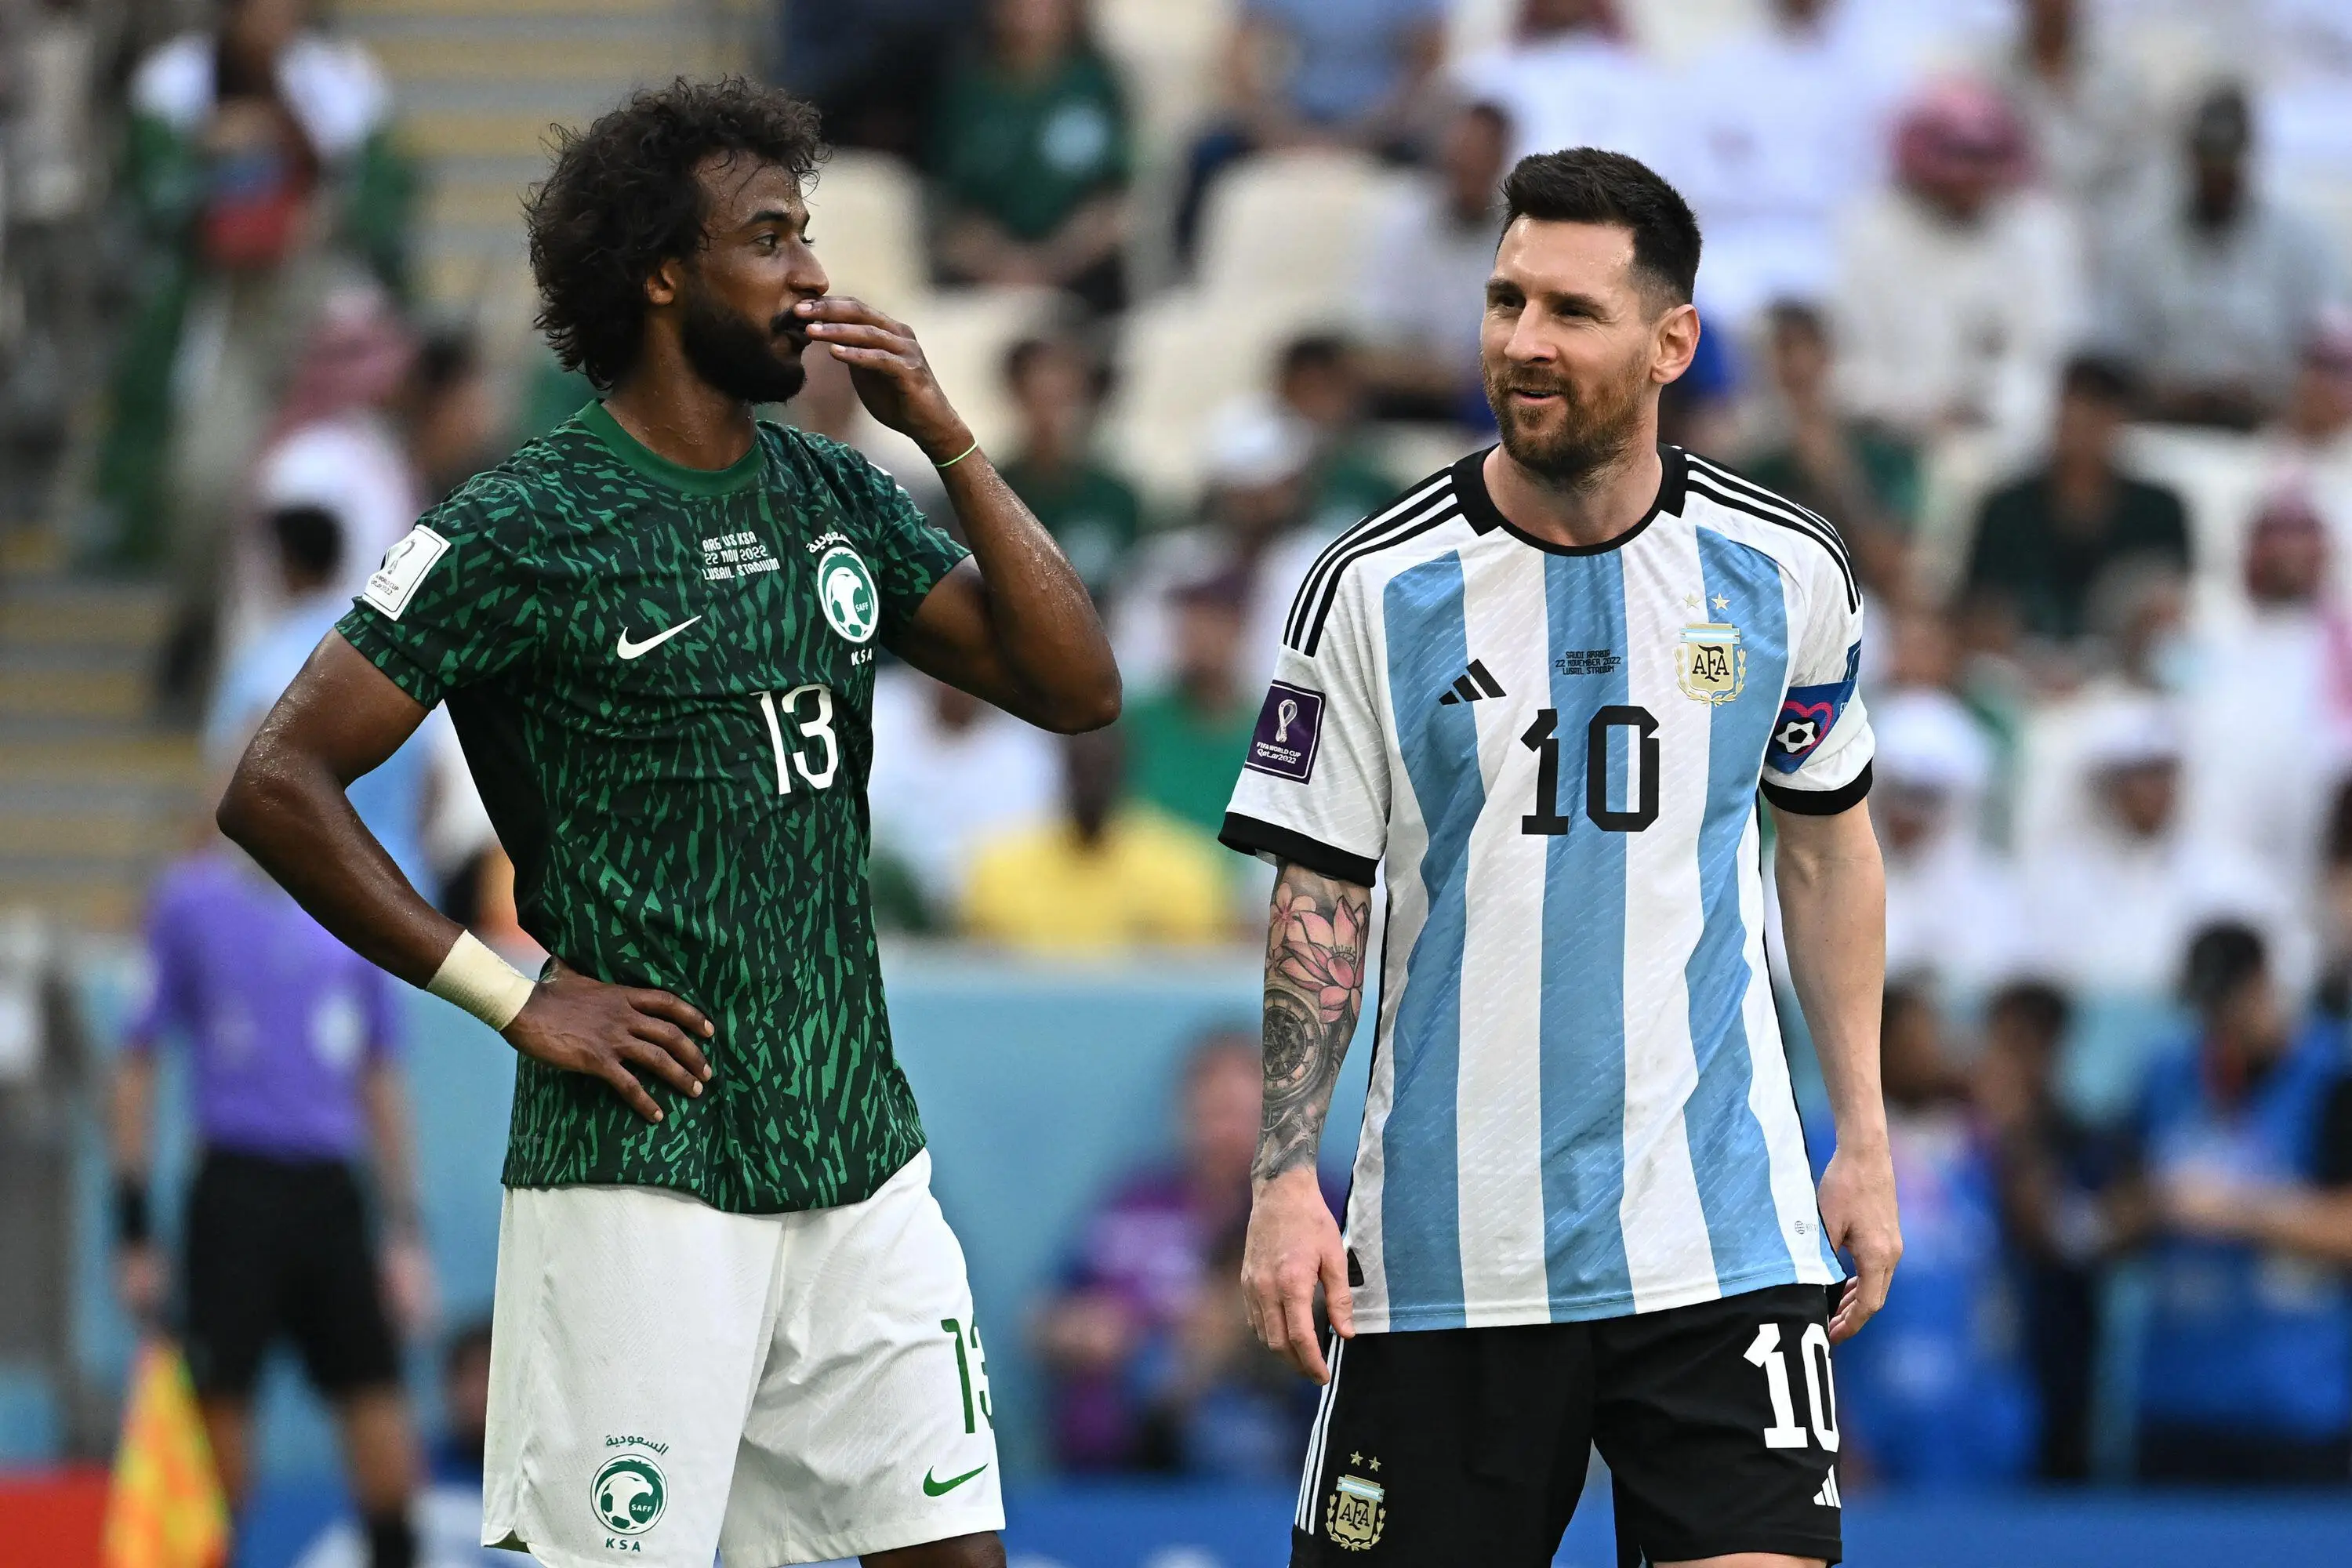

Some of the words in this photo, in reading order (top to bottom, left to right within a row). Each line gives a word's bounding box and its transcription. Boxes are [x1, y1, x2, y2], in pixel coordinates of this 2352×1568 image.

[702, 537, 722, 552] ARG
[737, 531, 757, 545] KSA
[704, 553, 719, 565] 22
[739, 544, 768, 561] 2022
[702, 566, 735, 580] LUSAIL
[736, 557, 780, 576] STADIUM
[855, 602, 869, 612] SAFF
[851, 648, 872, 666] KSA
[1568, 658, 1601, 667] NOVEMBER
[1603, 656, 1621, 665] 2022
[1692, 644, 1730, 682] AFA
[1563, 666, 1584, 675] LUSAIL
[1586, 665, 1614, 674] STADIUM
[749, 684, 839, 795] 13
[1269, 745, 1289, 754] WORLD
[1520, 705, 1660, 835] 10
[1743, 1323, 1840, 1453] 10
[604, 1434, 670, 1456] السعودية
[630, 1504, 652, 1512] SAFF
[1339, 1494, 1370, 1530] AFA
[605, 1537, 641, 1552] KSA
